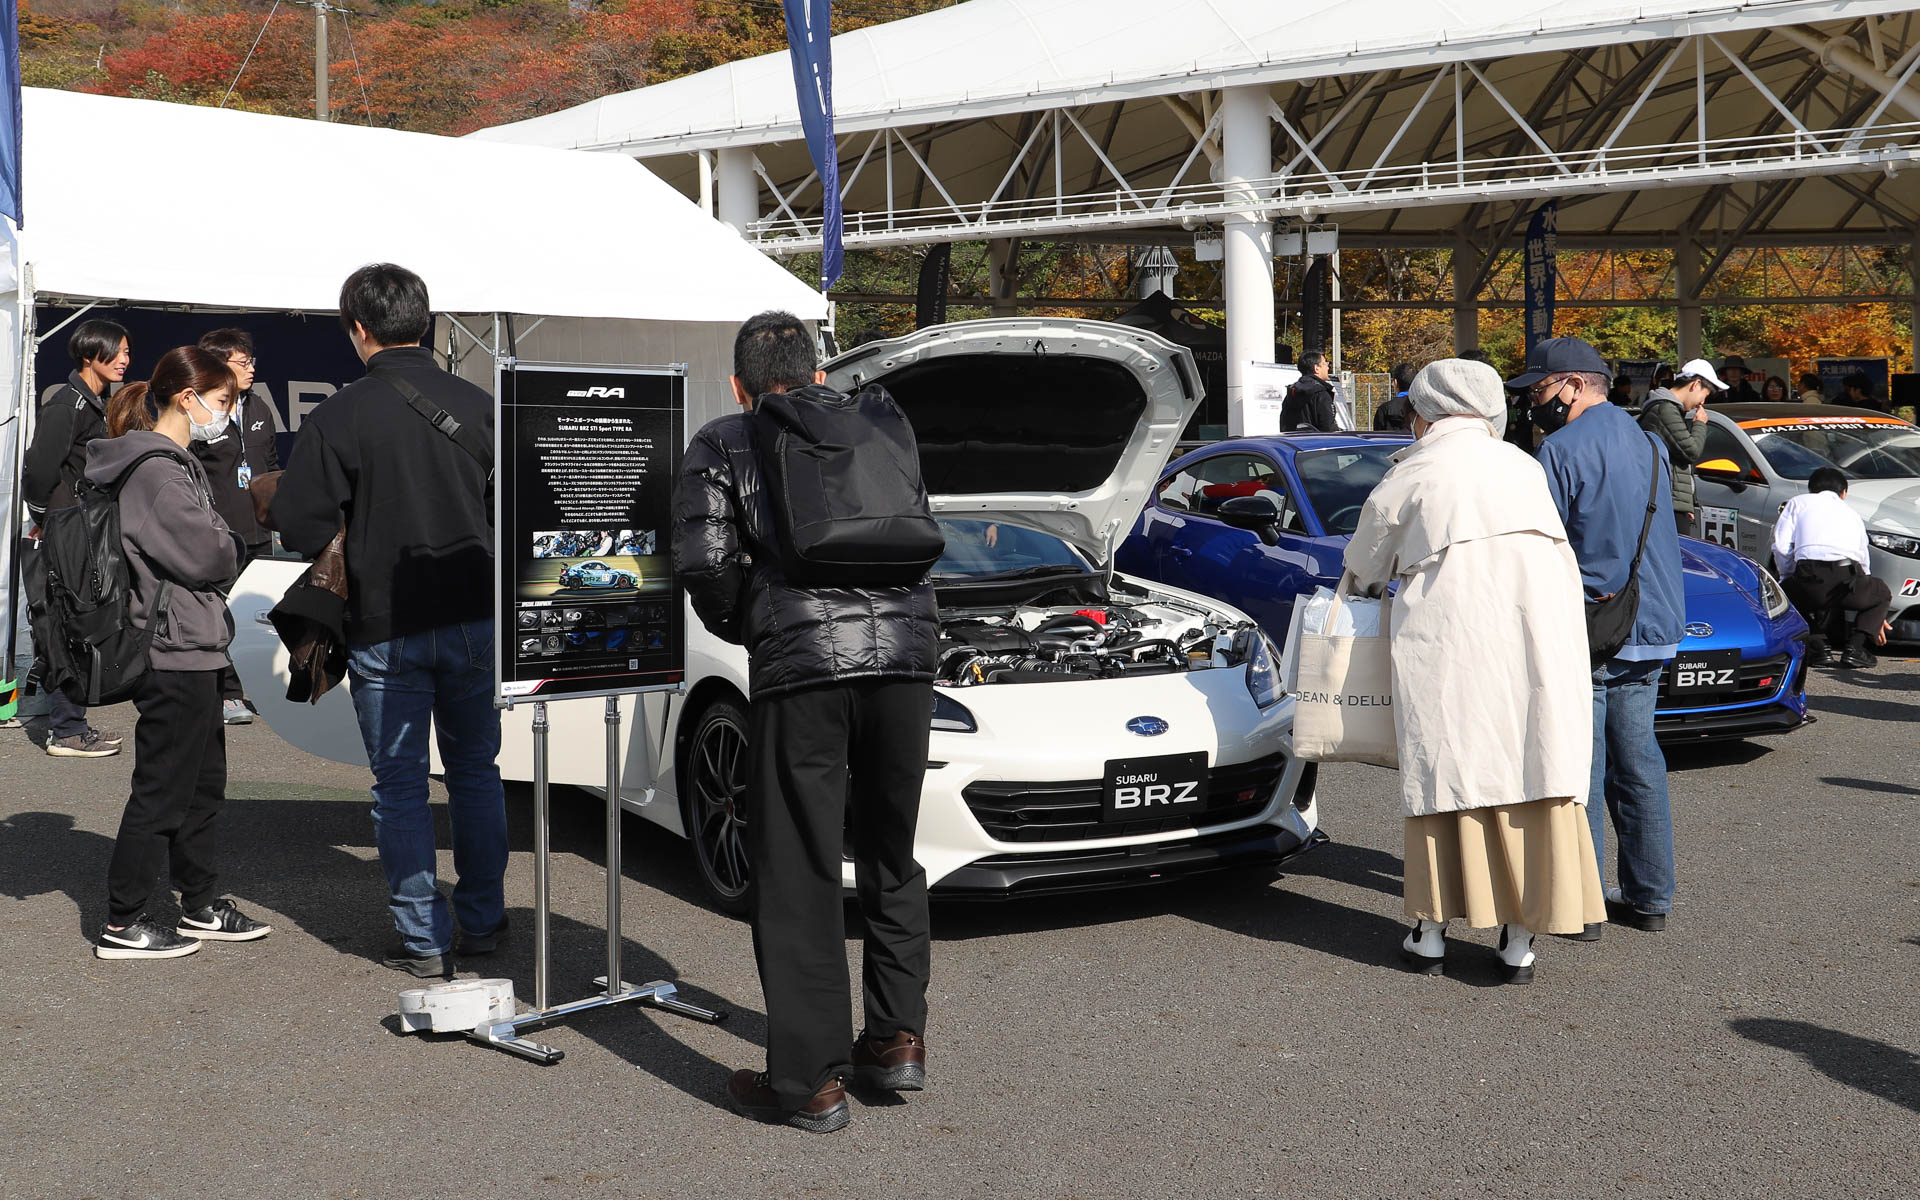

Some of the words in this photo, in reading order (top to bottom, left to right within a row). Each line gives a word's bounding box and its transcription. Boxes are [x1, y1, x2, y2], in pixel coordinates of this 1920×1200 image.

[1542, 206, 1558, 275] 水素で
[1195, 351, 1224, 361] MAZDA
[586, 386, 625, 399] RA
[1760, 424, 1818, 434] MAZDA
[1704, 521, 1736, 550] 55
[1678, 662, 1708, 670] SUBARU
[1676, 669, 1735, 687] BRZ
[1296, 691, 1329, 704] DEAN
[1332, 694, 1343, 706] &
[1115, 773, 1158, 786] SUBARU
[1114, 781, 1199, 810] BRZ
